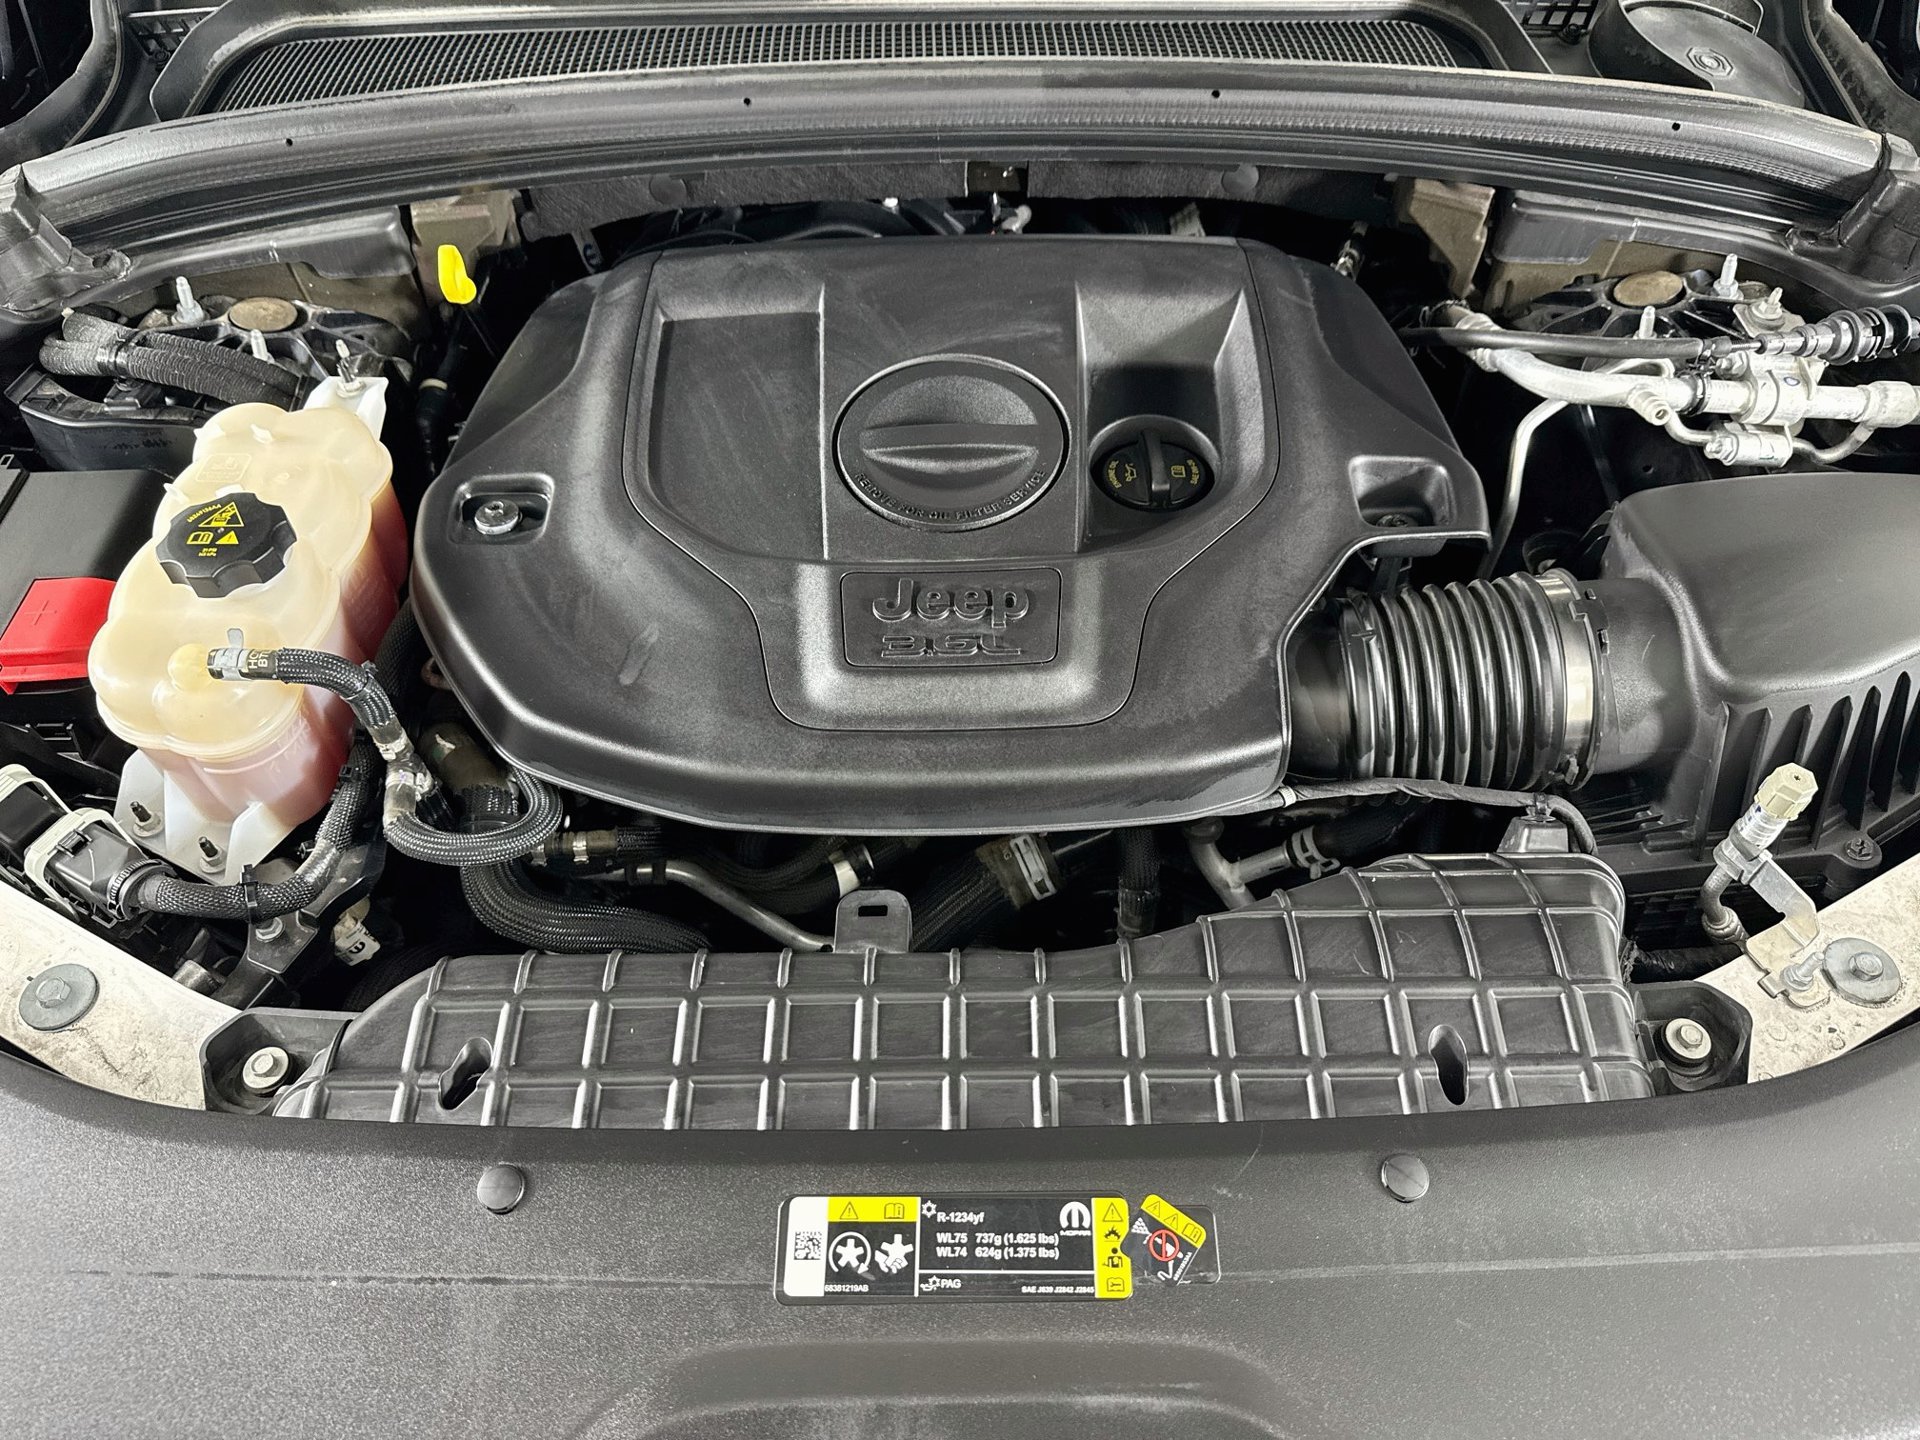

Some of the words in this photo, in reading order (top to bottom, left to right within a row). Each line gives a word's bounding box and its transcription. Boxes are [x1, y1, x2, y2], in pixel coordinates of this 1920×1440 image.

[855, 473, 896, 507] REMOVE
[898, 505, 925, 518] FOR
[928, 511, 950, 520] OIL
[956, 504, 1002, 520] FILTER
[1003, 470, 1046, 506] SERVICE
[872, 578, 1030, 629] Jeep
[881, 635, 1021, 658] 3.6L
[936, 1211, 985, 1226] R-1234yf
[936, 1232, 968, 1244] WL75
[975, 1232, 1003, 1246] 737g
[1003, 1232, 1037, 1246] (1.625
[1037, 1232, 1060, 1247] lbs)
[936, 1246, 968, 1258] WL74
[975, 1246, 1003, 1260] 624g
[1003, 1246, 1037, 1260] (1.375
[1038, 1246, 1060, 1261] lbs)
[940, 1278, 962, 1289] PAG
[1021, 1285, 1037, 1294] SAE
